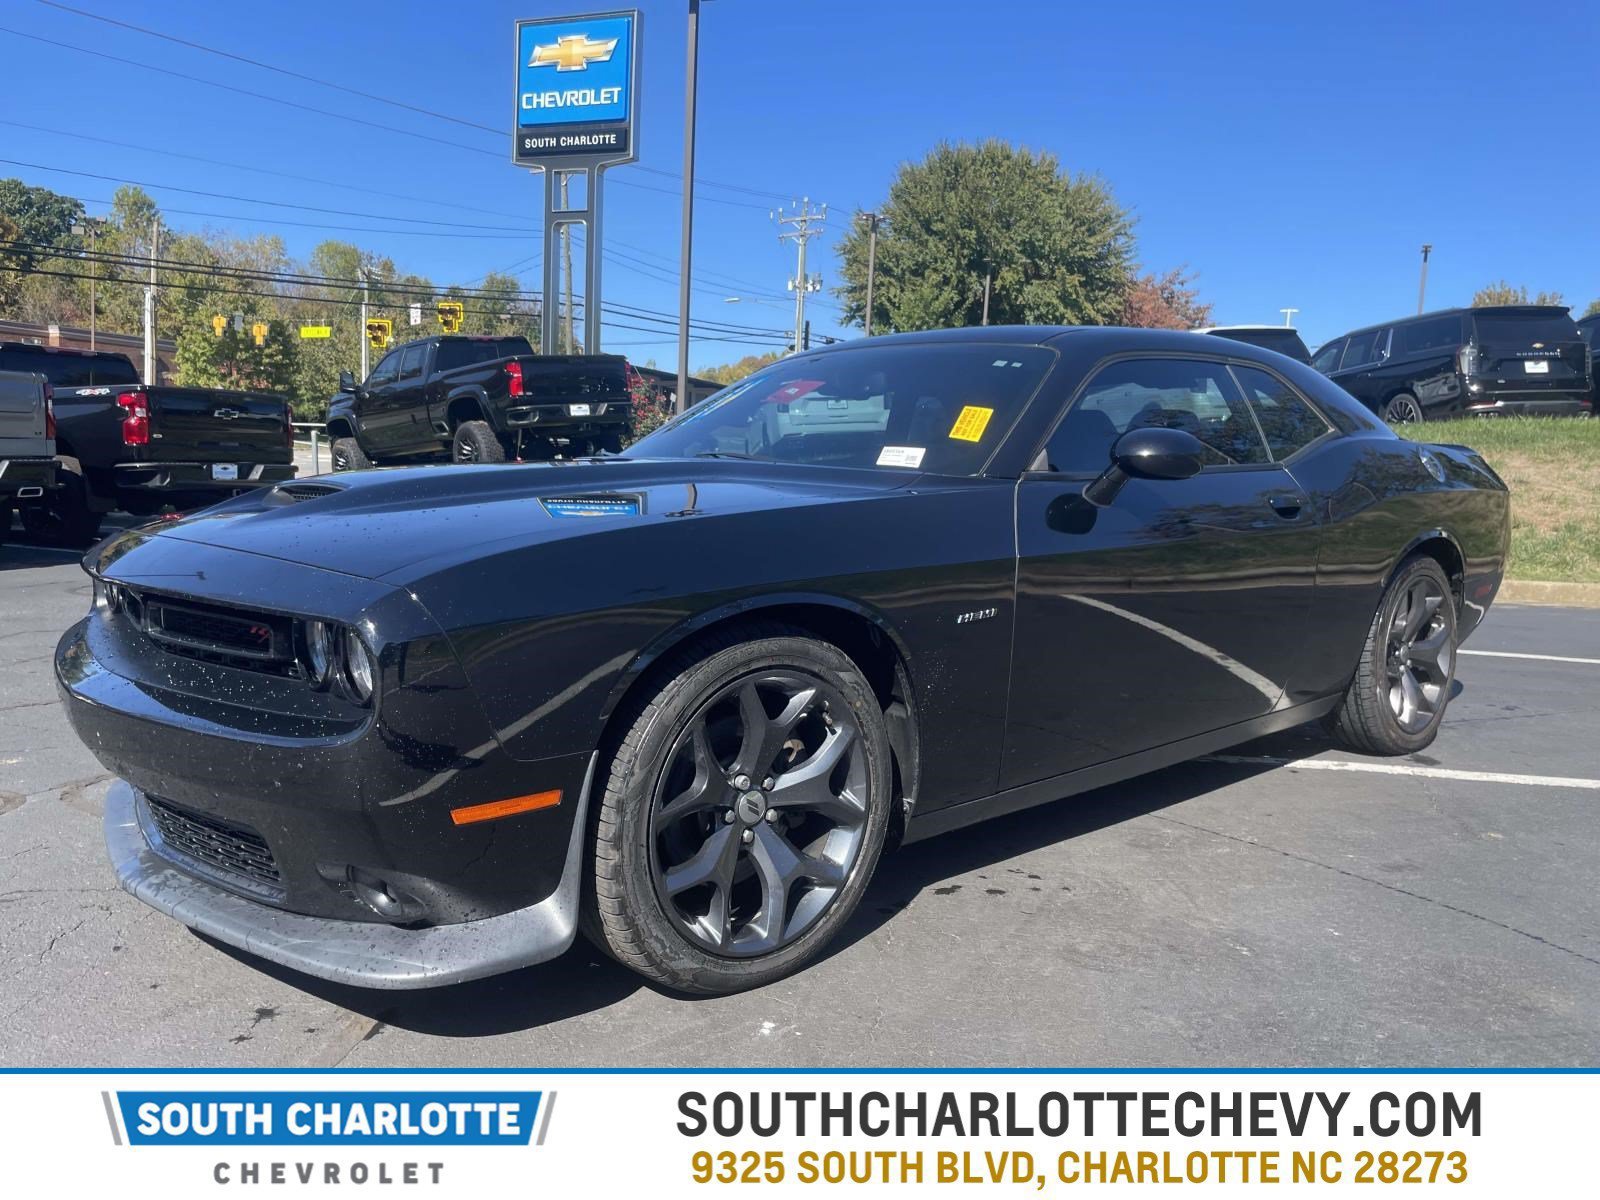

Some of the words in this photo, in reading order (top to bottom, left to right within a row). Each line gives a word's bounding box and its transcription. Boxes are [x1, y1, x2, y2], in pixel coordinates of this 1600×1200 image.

[522, 87, 622, 109] CHEVROLET
[525, 137, 557, 149] SOUTH
[560, 134, 617, 147] CHARLOTTE
